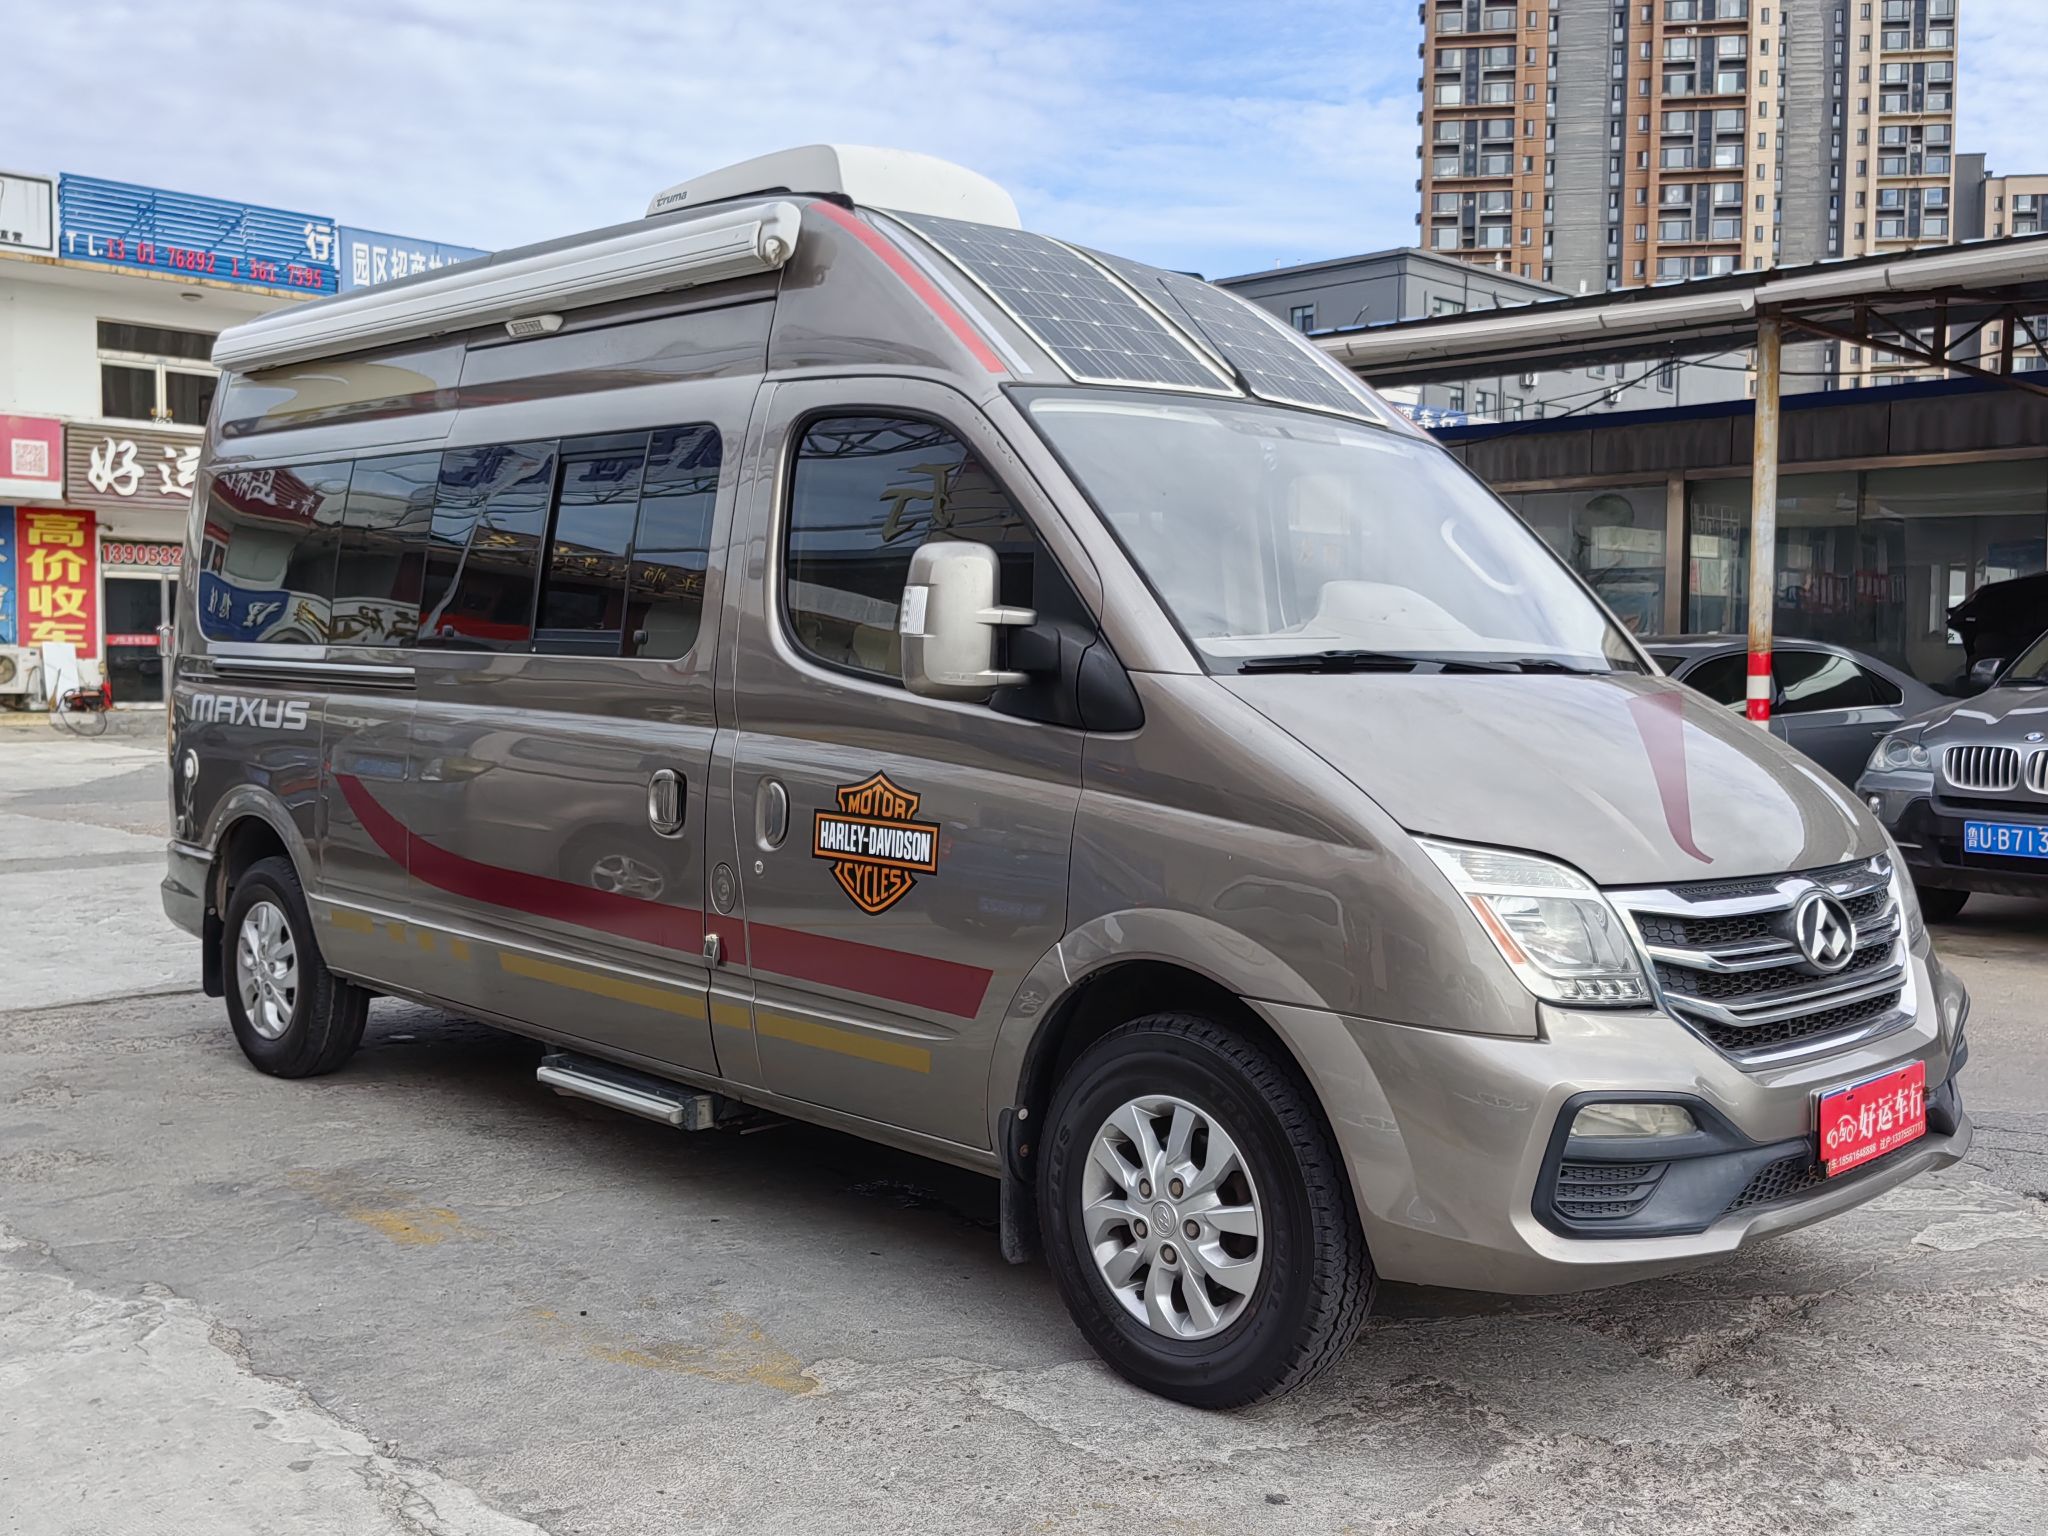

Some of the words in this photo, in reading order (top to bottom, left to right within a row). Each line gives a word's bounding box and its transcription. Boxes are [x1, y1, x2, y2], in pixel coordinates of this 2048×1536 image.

[304, 222, 332, 261] 行
[25, 514, 88, 649] 高价收车
[190, 693, 310, 730] MAXUS
[848, 783, 906, 819] MOTOR
[820, 820, 931, 863] HARLEY-DAVIDSON
[843, 861, 900, 905] CYCLES
[1858, 1081, 1922, 1141] 好运车行
